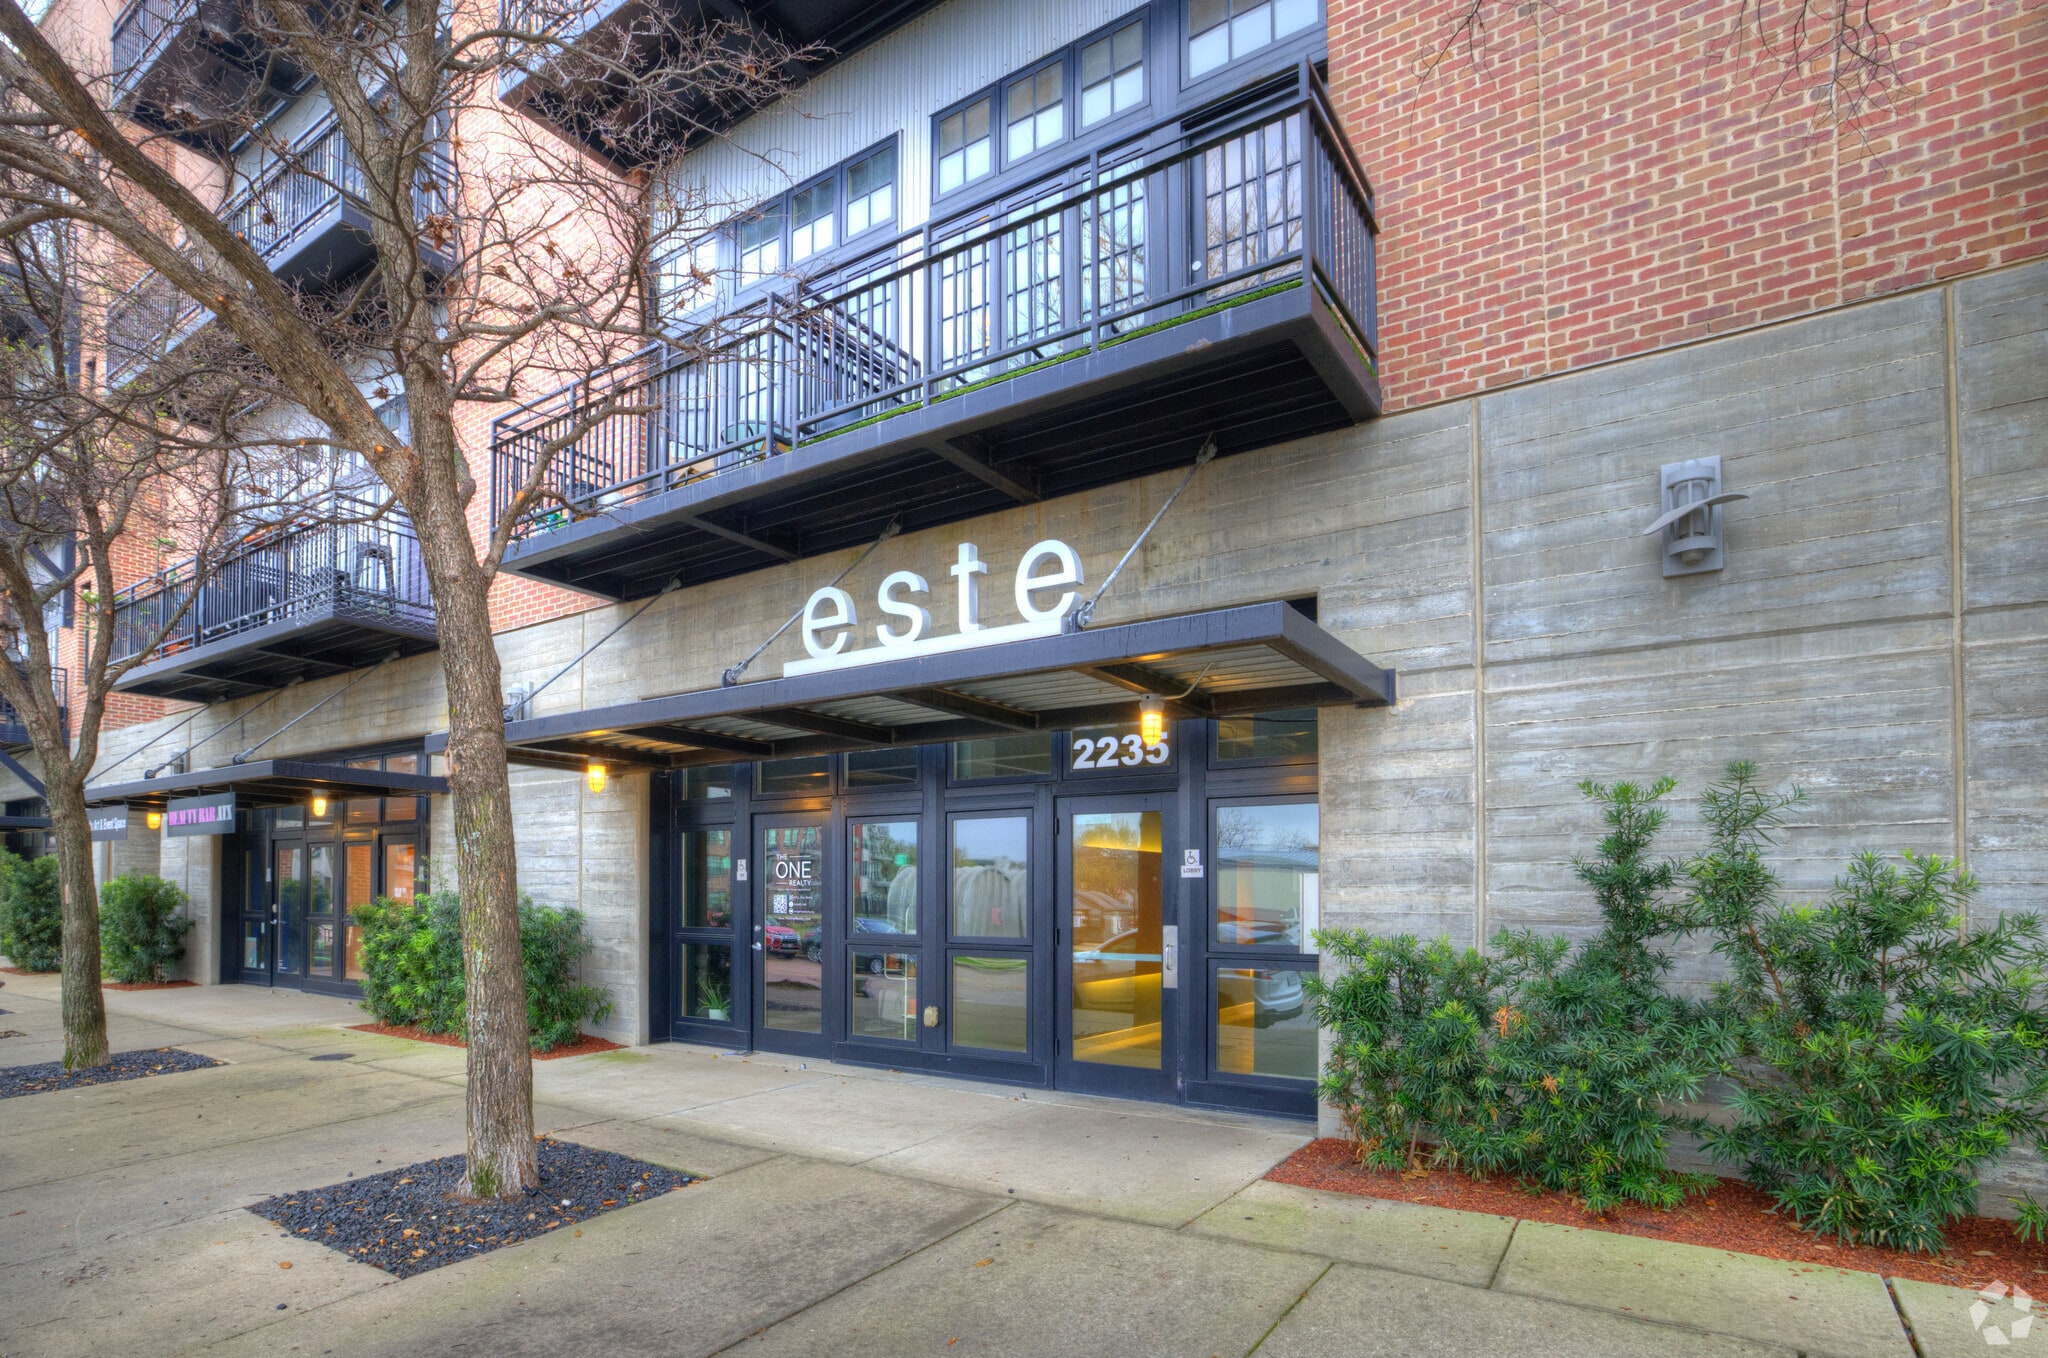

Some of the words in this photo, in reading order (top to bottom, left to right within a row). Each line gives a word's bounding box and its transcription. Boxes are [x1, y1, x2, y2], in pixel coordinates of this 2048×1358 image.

[802, 540, 1084, 660] este
[1073, 732, 1169, 769] 2235
[169, 809, 197, 826] BEAUTY
[198, 806, 216, 823] BAR
[216, 804, 232, 821] ATX
[775, 861, 811, 878] ONE
